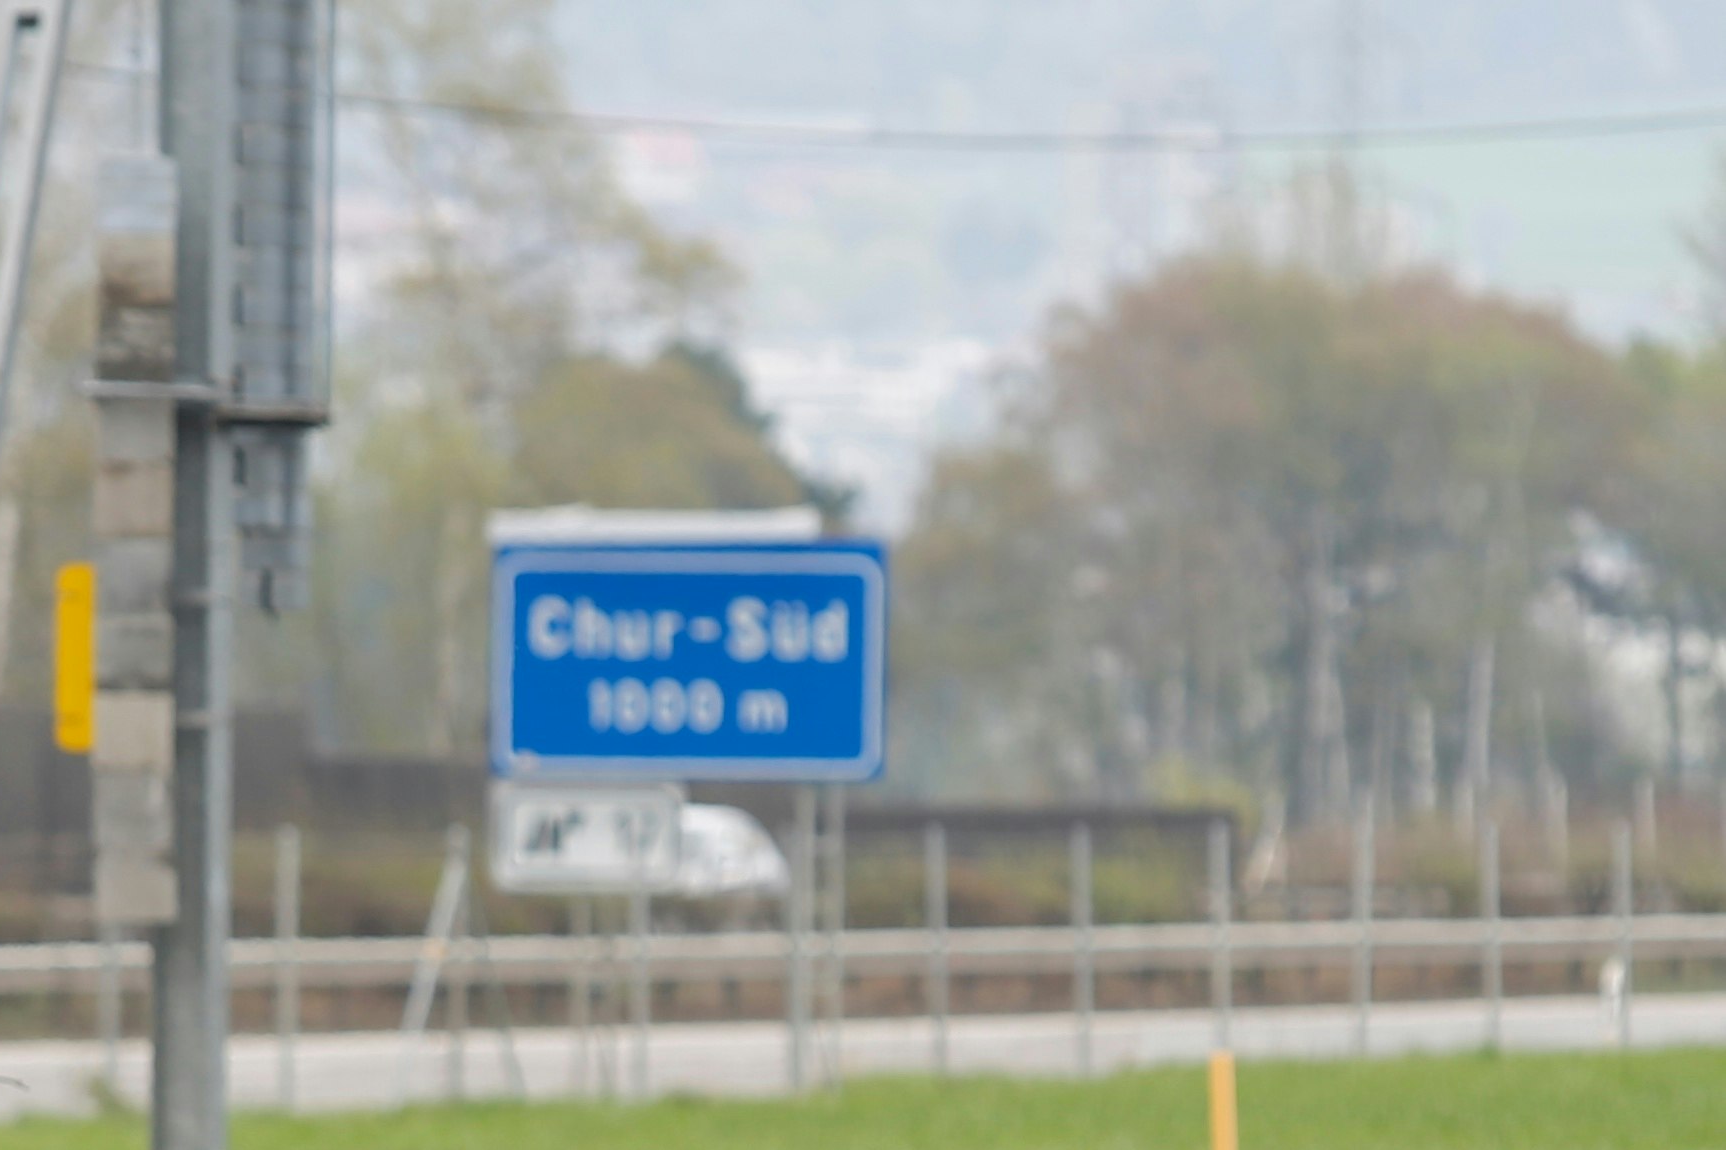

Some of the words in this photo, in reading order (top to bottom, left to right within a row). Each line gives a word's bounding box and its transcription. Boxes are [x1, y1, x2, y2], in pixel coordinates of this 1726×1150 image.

[527, 594, 849, 662] Chur-Süd
[588, 677, 725, 734] 1000
[736, 689, 789, 734] m
